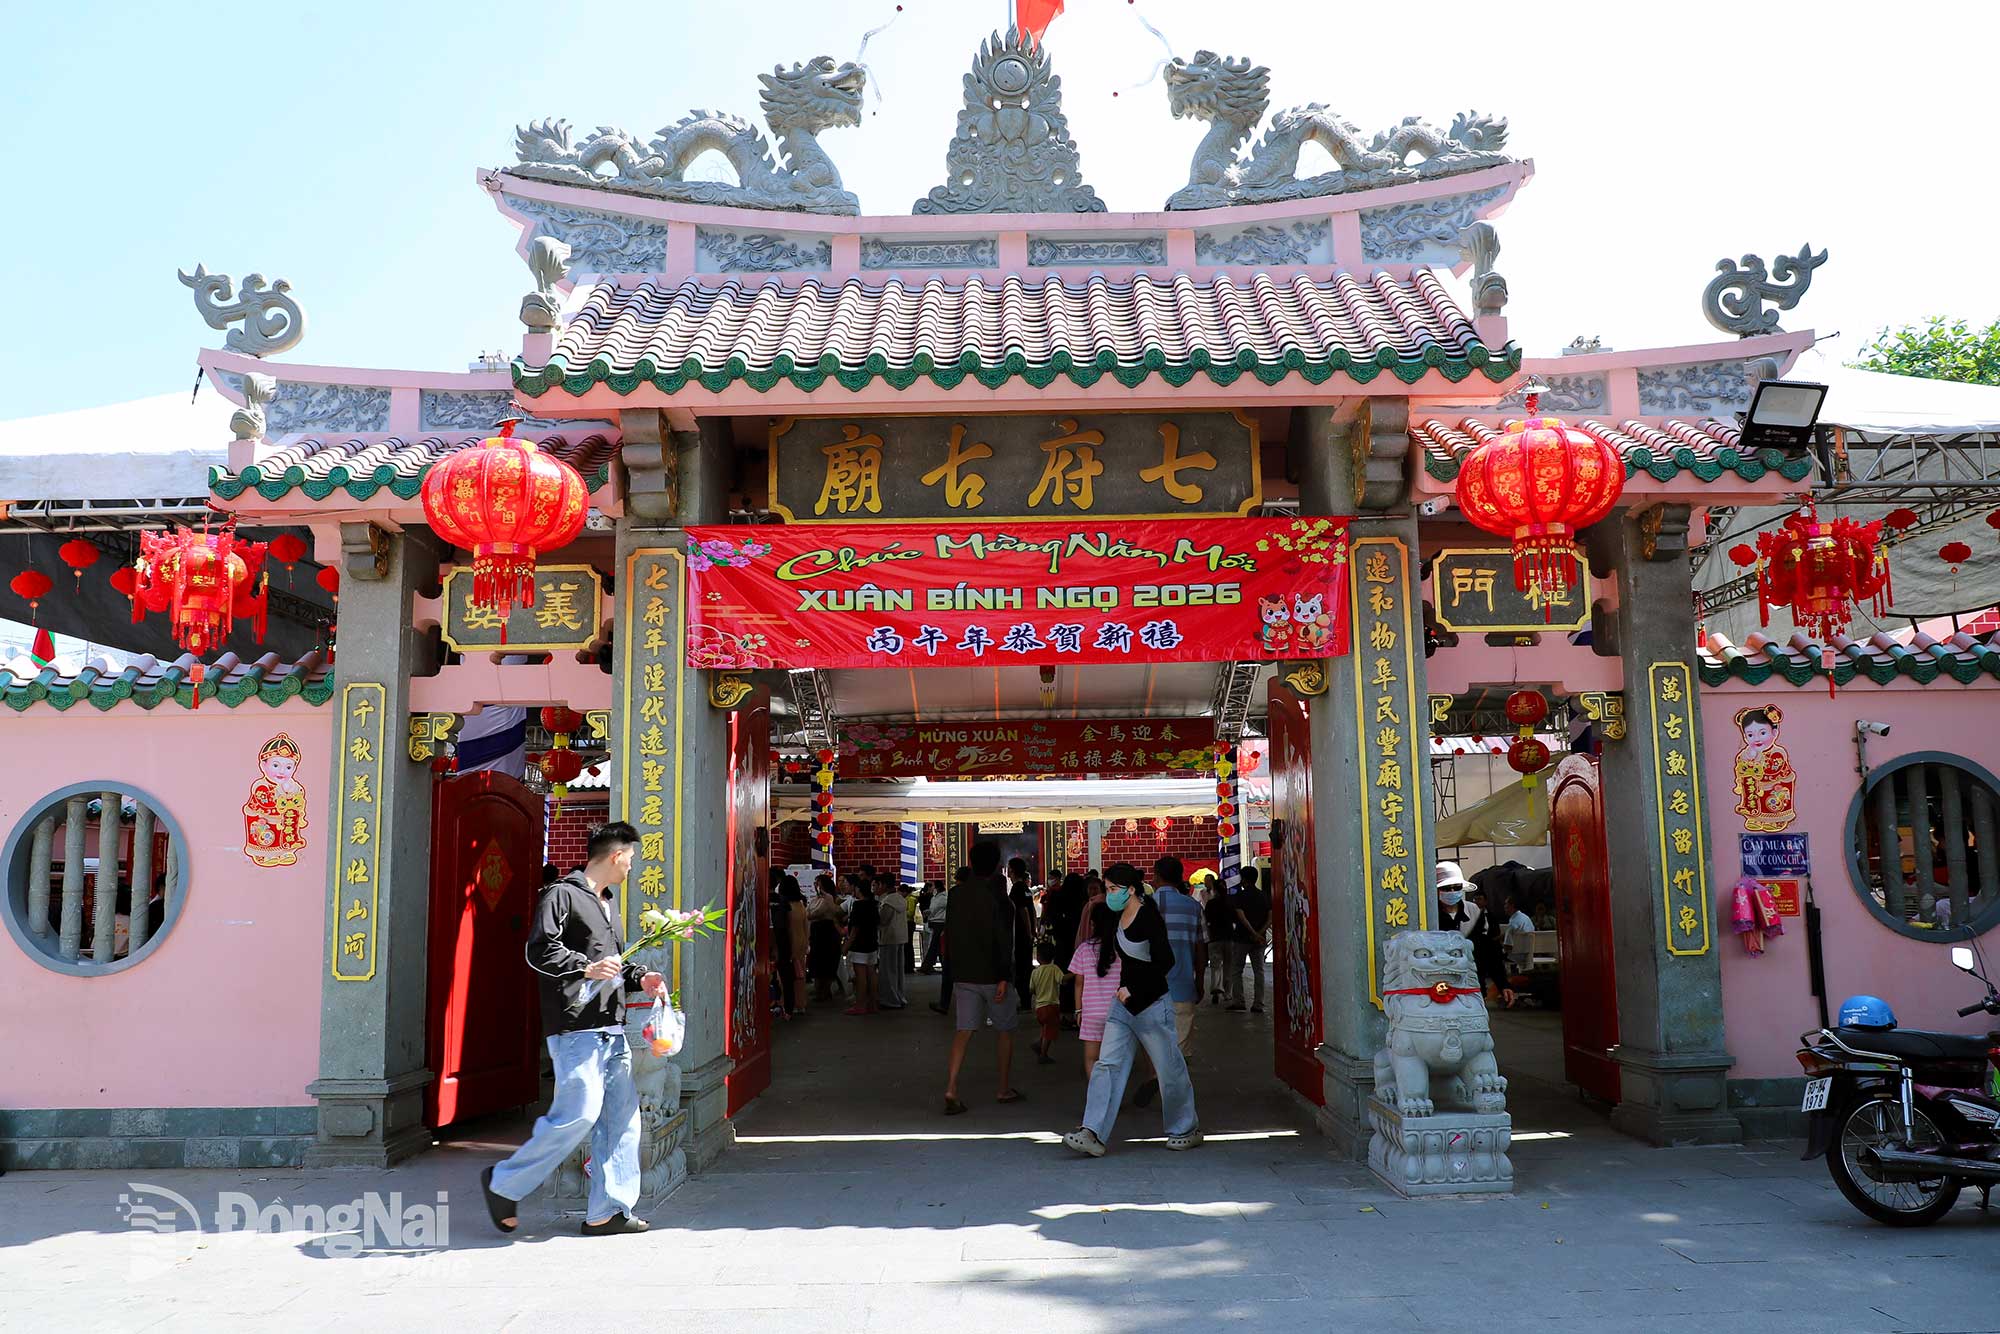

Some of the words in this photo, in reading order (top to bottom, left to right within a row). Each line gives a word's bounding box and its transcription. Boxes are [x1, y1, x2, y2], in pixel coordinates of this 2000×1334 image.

[815, 418, 1219, 516] 七府古廟
[775, 542, 924, 581] Chúc
[935, 533, 1062, 574] Mừng
[1065, 532, 1168, 569] Năm
[1172, 539, 1259, 573] Mới
[796, 582, 914, 612] XUÂN
[926, 582, 1023, 611] BÍNH
[1036, 585, 1119, 613] NGỌ
[1132, 582, 1242, 608] 2026
[866, 620, 1184, 655] 丙午年恭賀新禧
[919, 728, 968, 744] MỪNG
[972, 727, 1019, 743] XUÂN
[1079, 724, 1181, 743] 金馬迎春
